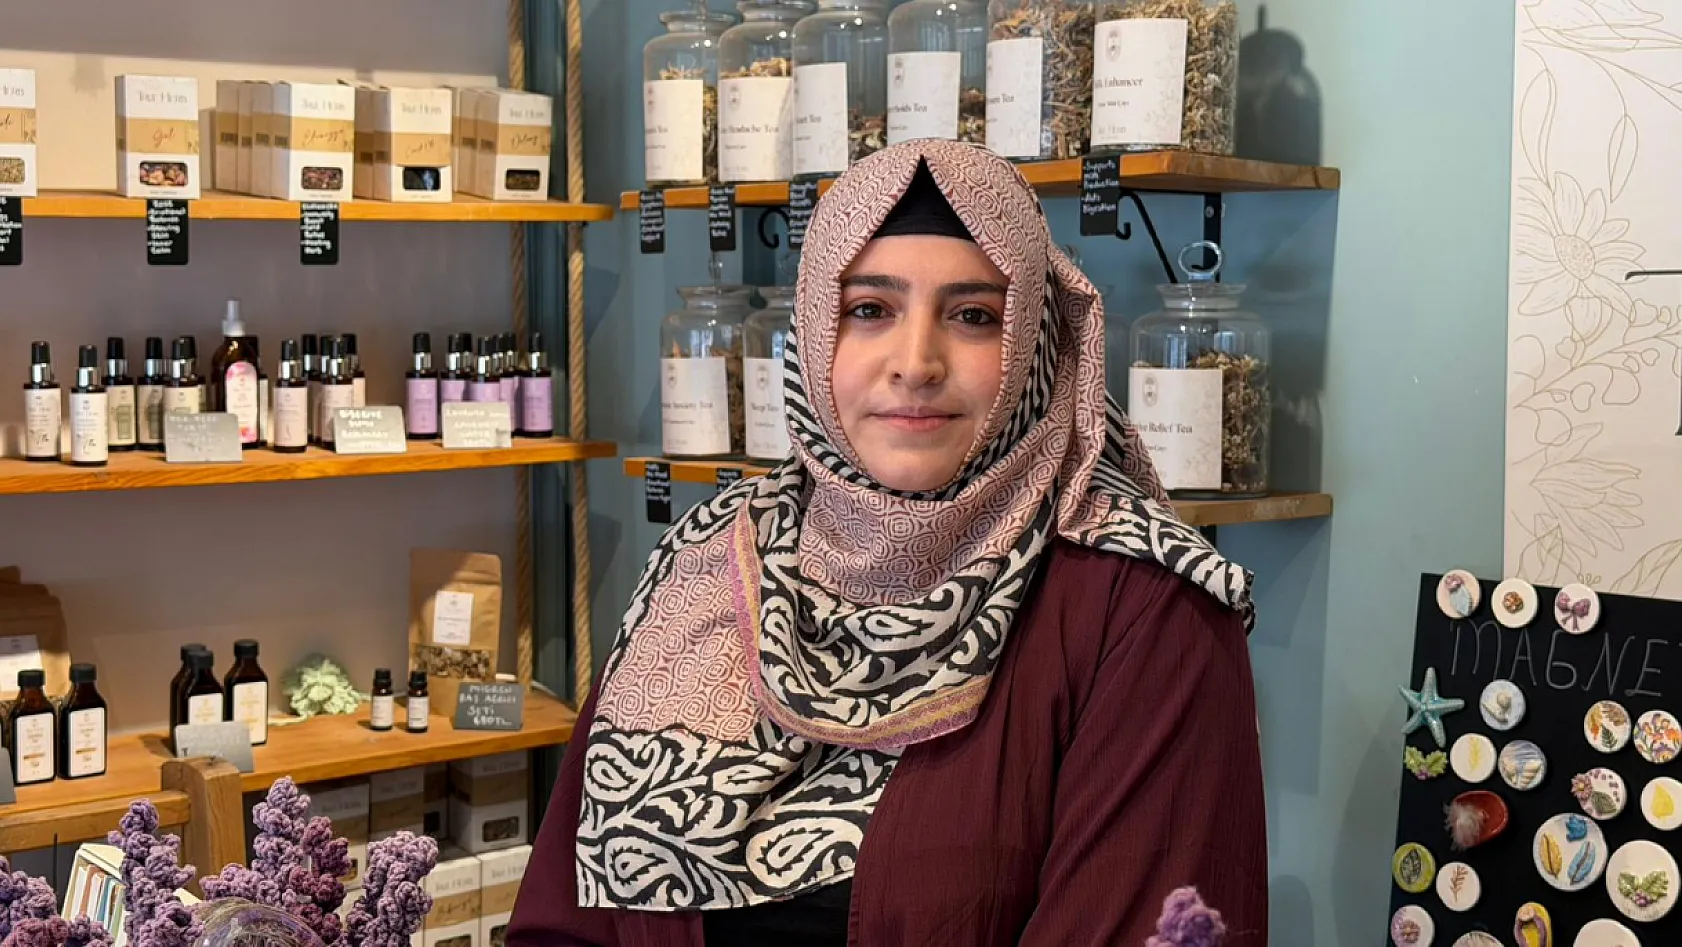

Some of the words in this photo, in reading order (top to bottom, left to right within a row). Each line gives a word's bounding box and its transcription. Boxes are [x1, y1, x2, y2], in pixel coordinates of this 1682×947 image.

[1149, 422, 1172, 433] Relief
[1175, 423, 1193, 433] Tea
[1450, 619, 1682, 697] MAGNE
